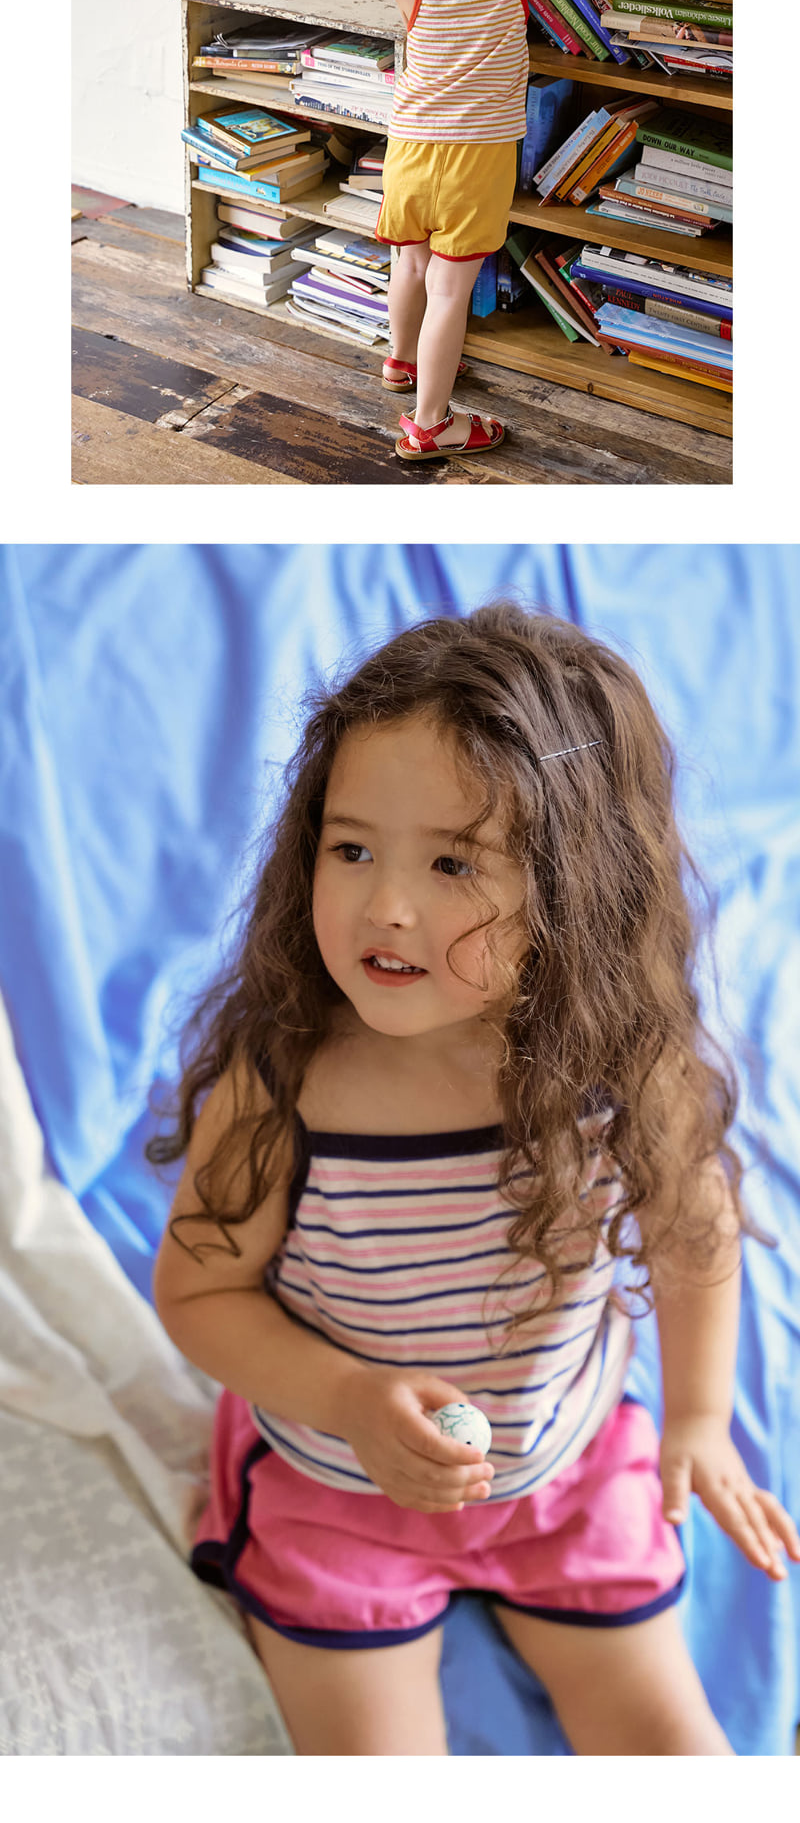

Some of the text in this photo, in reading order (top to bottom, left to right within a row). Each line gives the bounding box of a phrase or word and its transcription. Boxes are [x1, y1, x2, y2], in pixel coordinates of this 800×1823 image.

[618, 1, 732, 27] Unsere schönsten Volkslieder
[576, 23, 592, 42] Good
[590, 41, 603, 55] Our
[642, 134, 662, 146] DOWN
[664, 139, 677, 151] OUR
[679, 145, 695, 157] WAY
[607, 294, 641, 311] KENNEDY
[615, 288, 633, 300] PAUL
